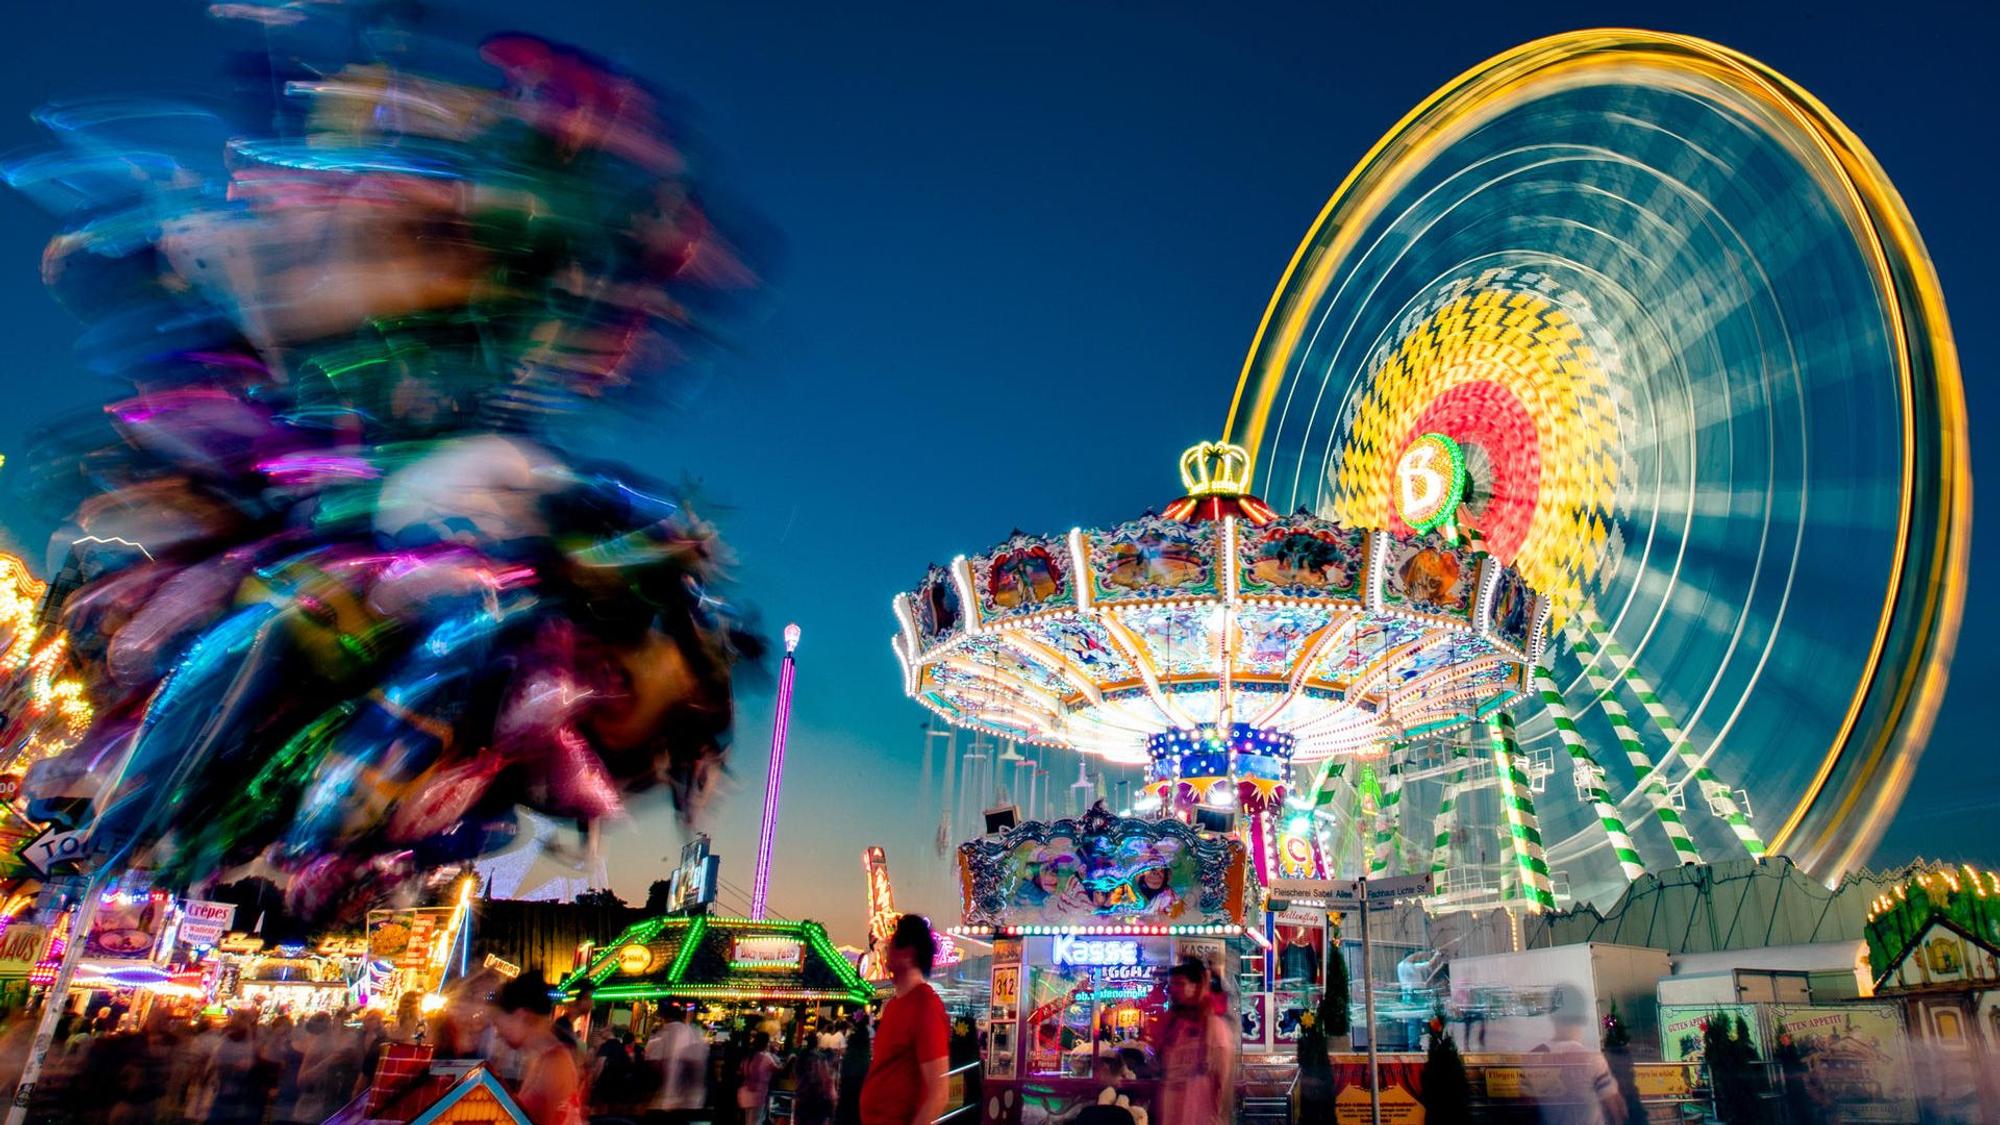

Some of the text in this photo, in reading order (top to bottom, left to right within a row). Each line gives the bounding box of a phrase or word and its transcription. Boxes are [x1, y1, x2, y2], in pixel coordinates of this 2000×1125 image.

[1395, 445, 1443, 518] B
[40, 836, 125, 858] TOIL
[1273, 887, 1311, 897] Fleischerei
[1278, 910, 1319, 924] Wellenflug
[1052, 934, 1138, 965] Kasse
[995, 978, 1015, 996] 312
[1783, 1014, 1842, 1033] UTEN APPETIT
